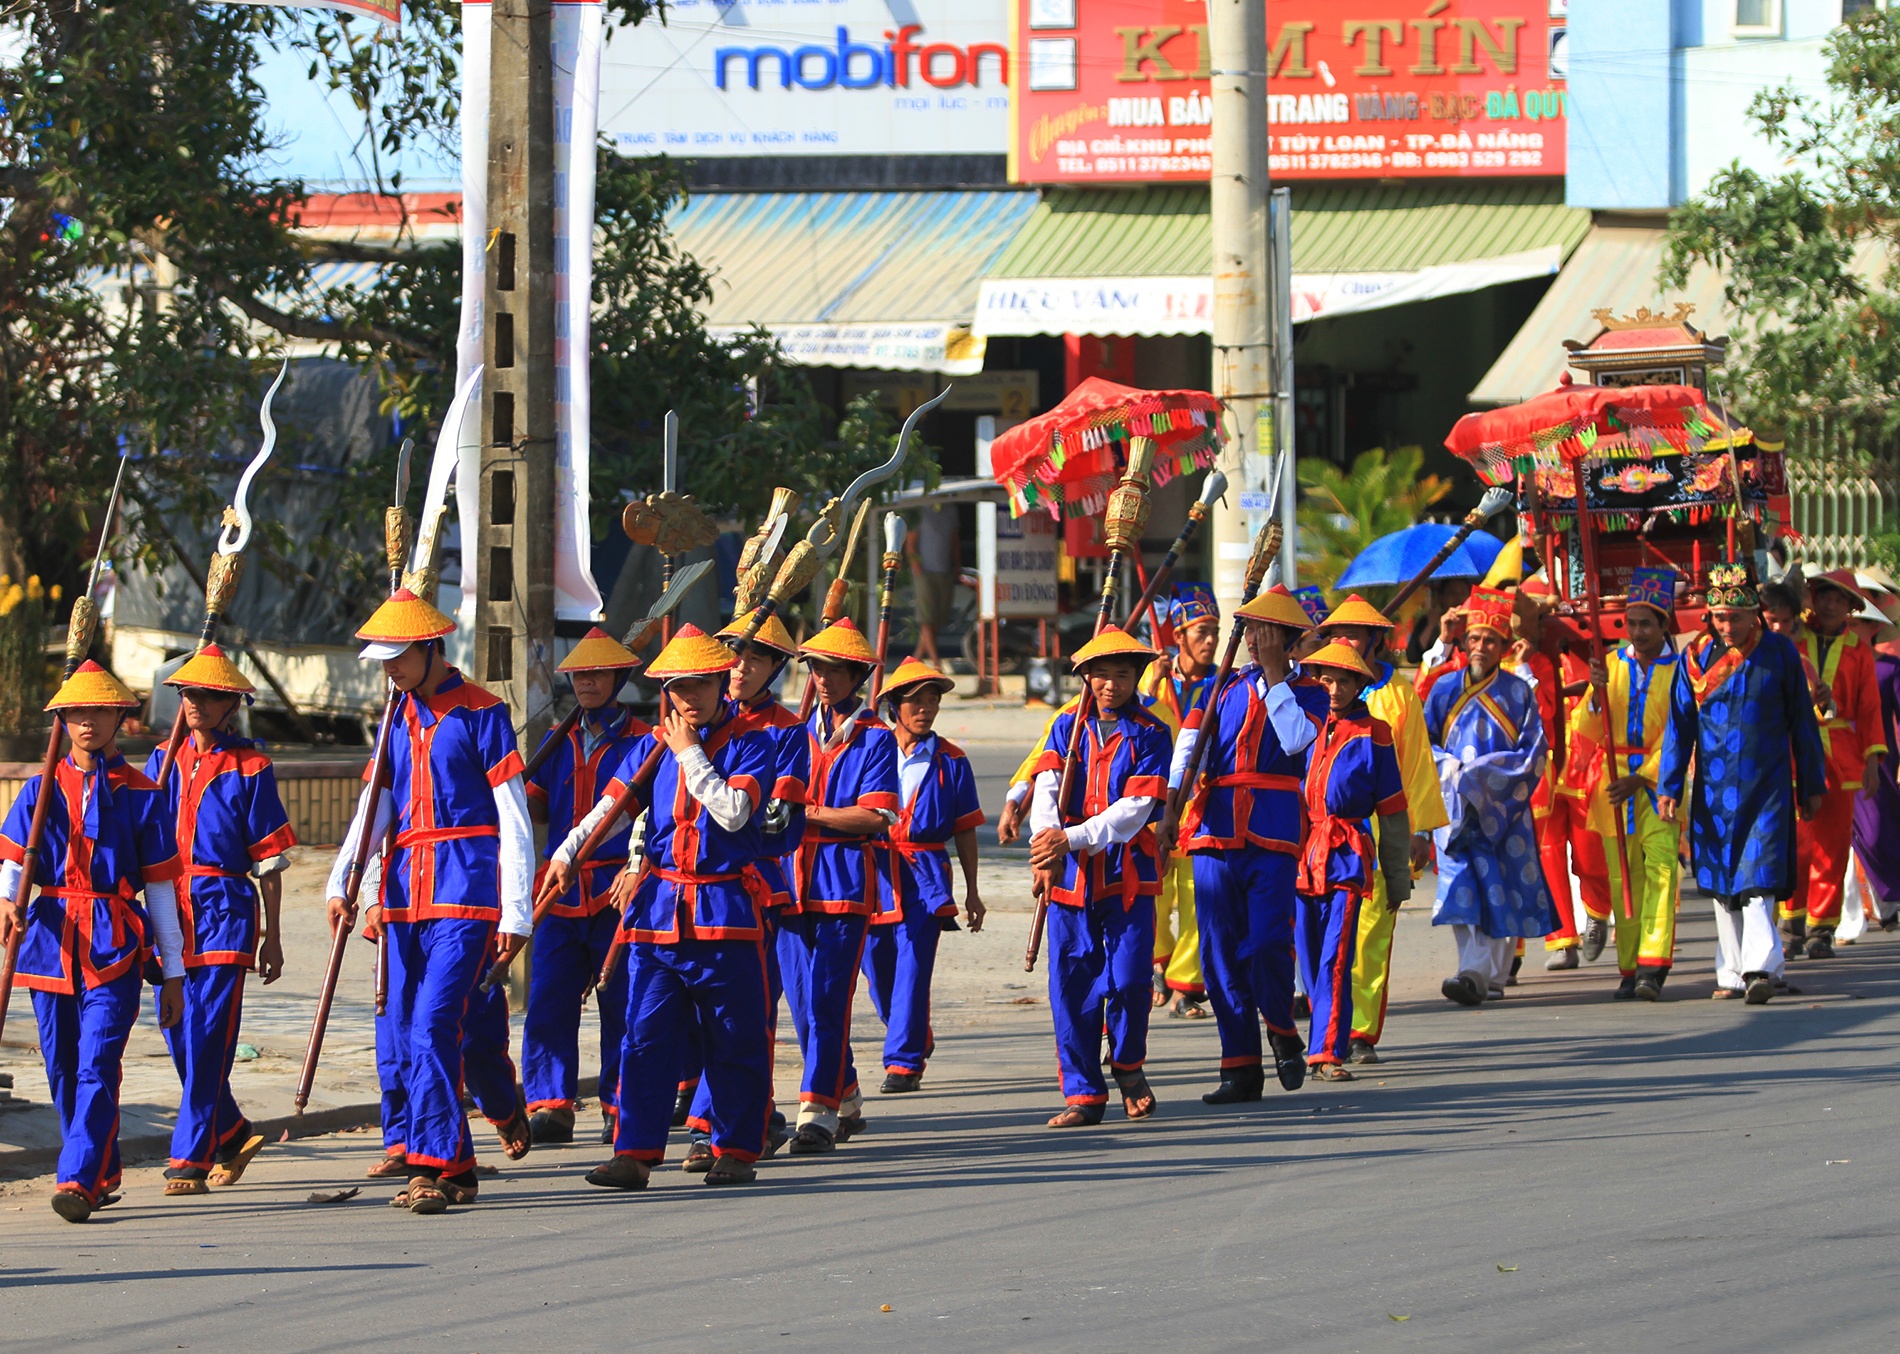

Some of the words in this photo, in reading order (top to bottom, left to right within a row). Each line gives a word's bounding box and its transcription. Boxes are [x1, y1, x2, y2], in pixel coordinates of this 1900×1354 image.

[1343, 1, 1526, 76] TÍN
[1108, 96, 1165, 127] MUA
[1267, 93, 1349, 124] TRANG
[616, 132, 656, 144] TRUNG
[1323, 135, 1385, 151] LOAN
